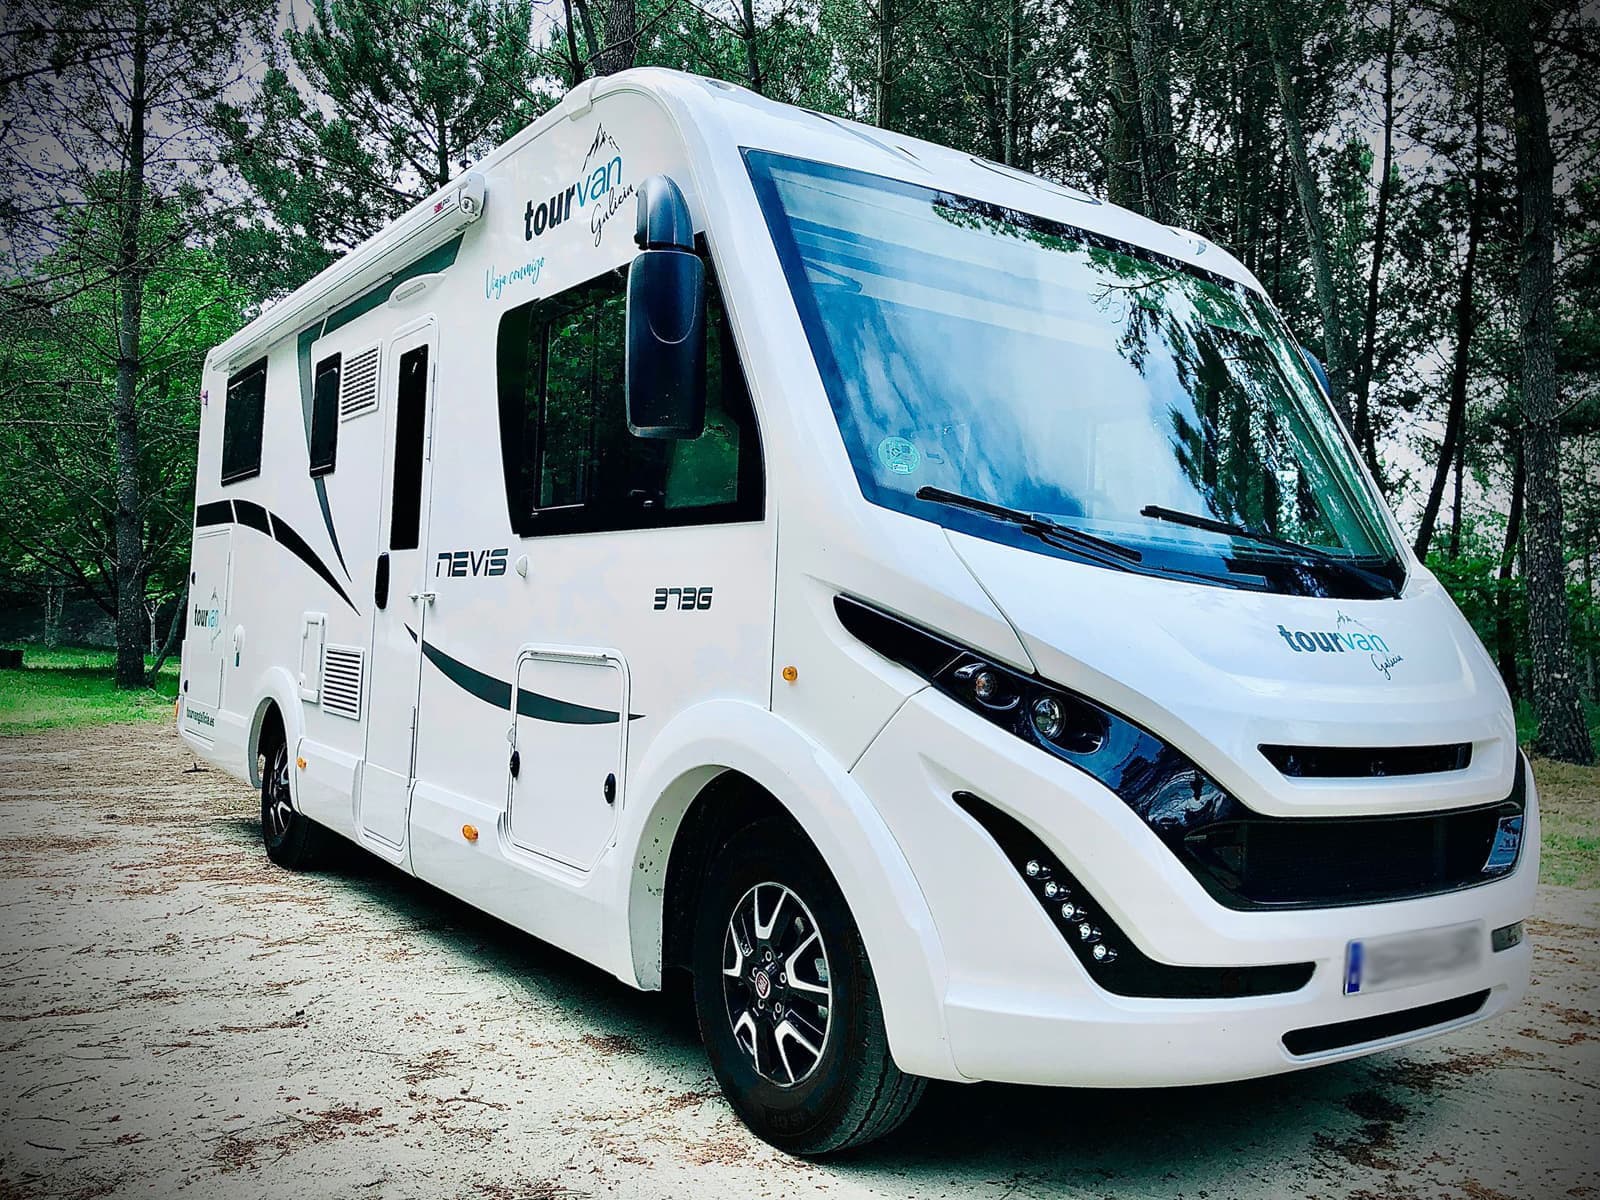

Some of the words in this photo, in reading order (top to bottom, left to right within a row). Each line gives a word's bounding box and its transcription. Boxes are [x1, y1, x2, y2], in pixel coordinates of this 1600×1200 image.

[523, 155, 622, 241] tourvan
[193, 603, 219, 628] tourvan
[1276, 624, 1390, 653] tourvan
